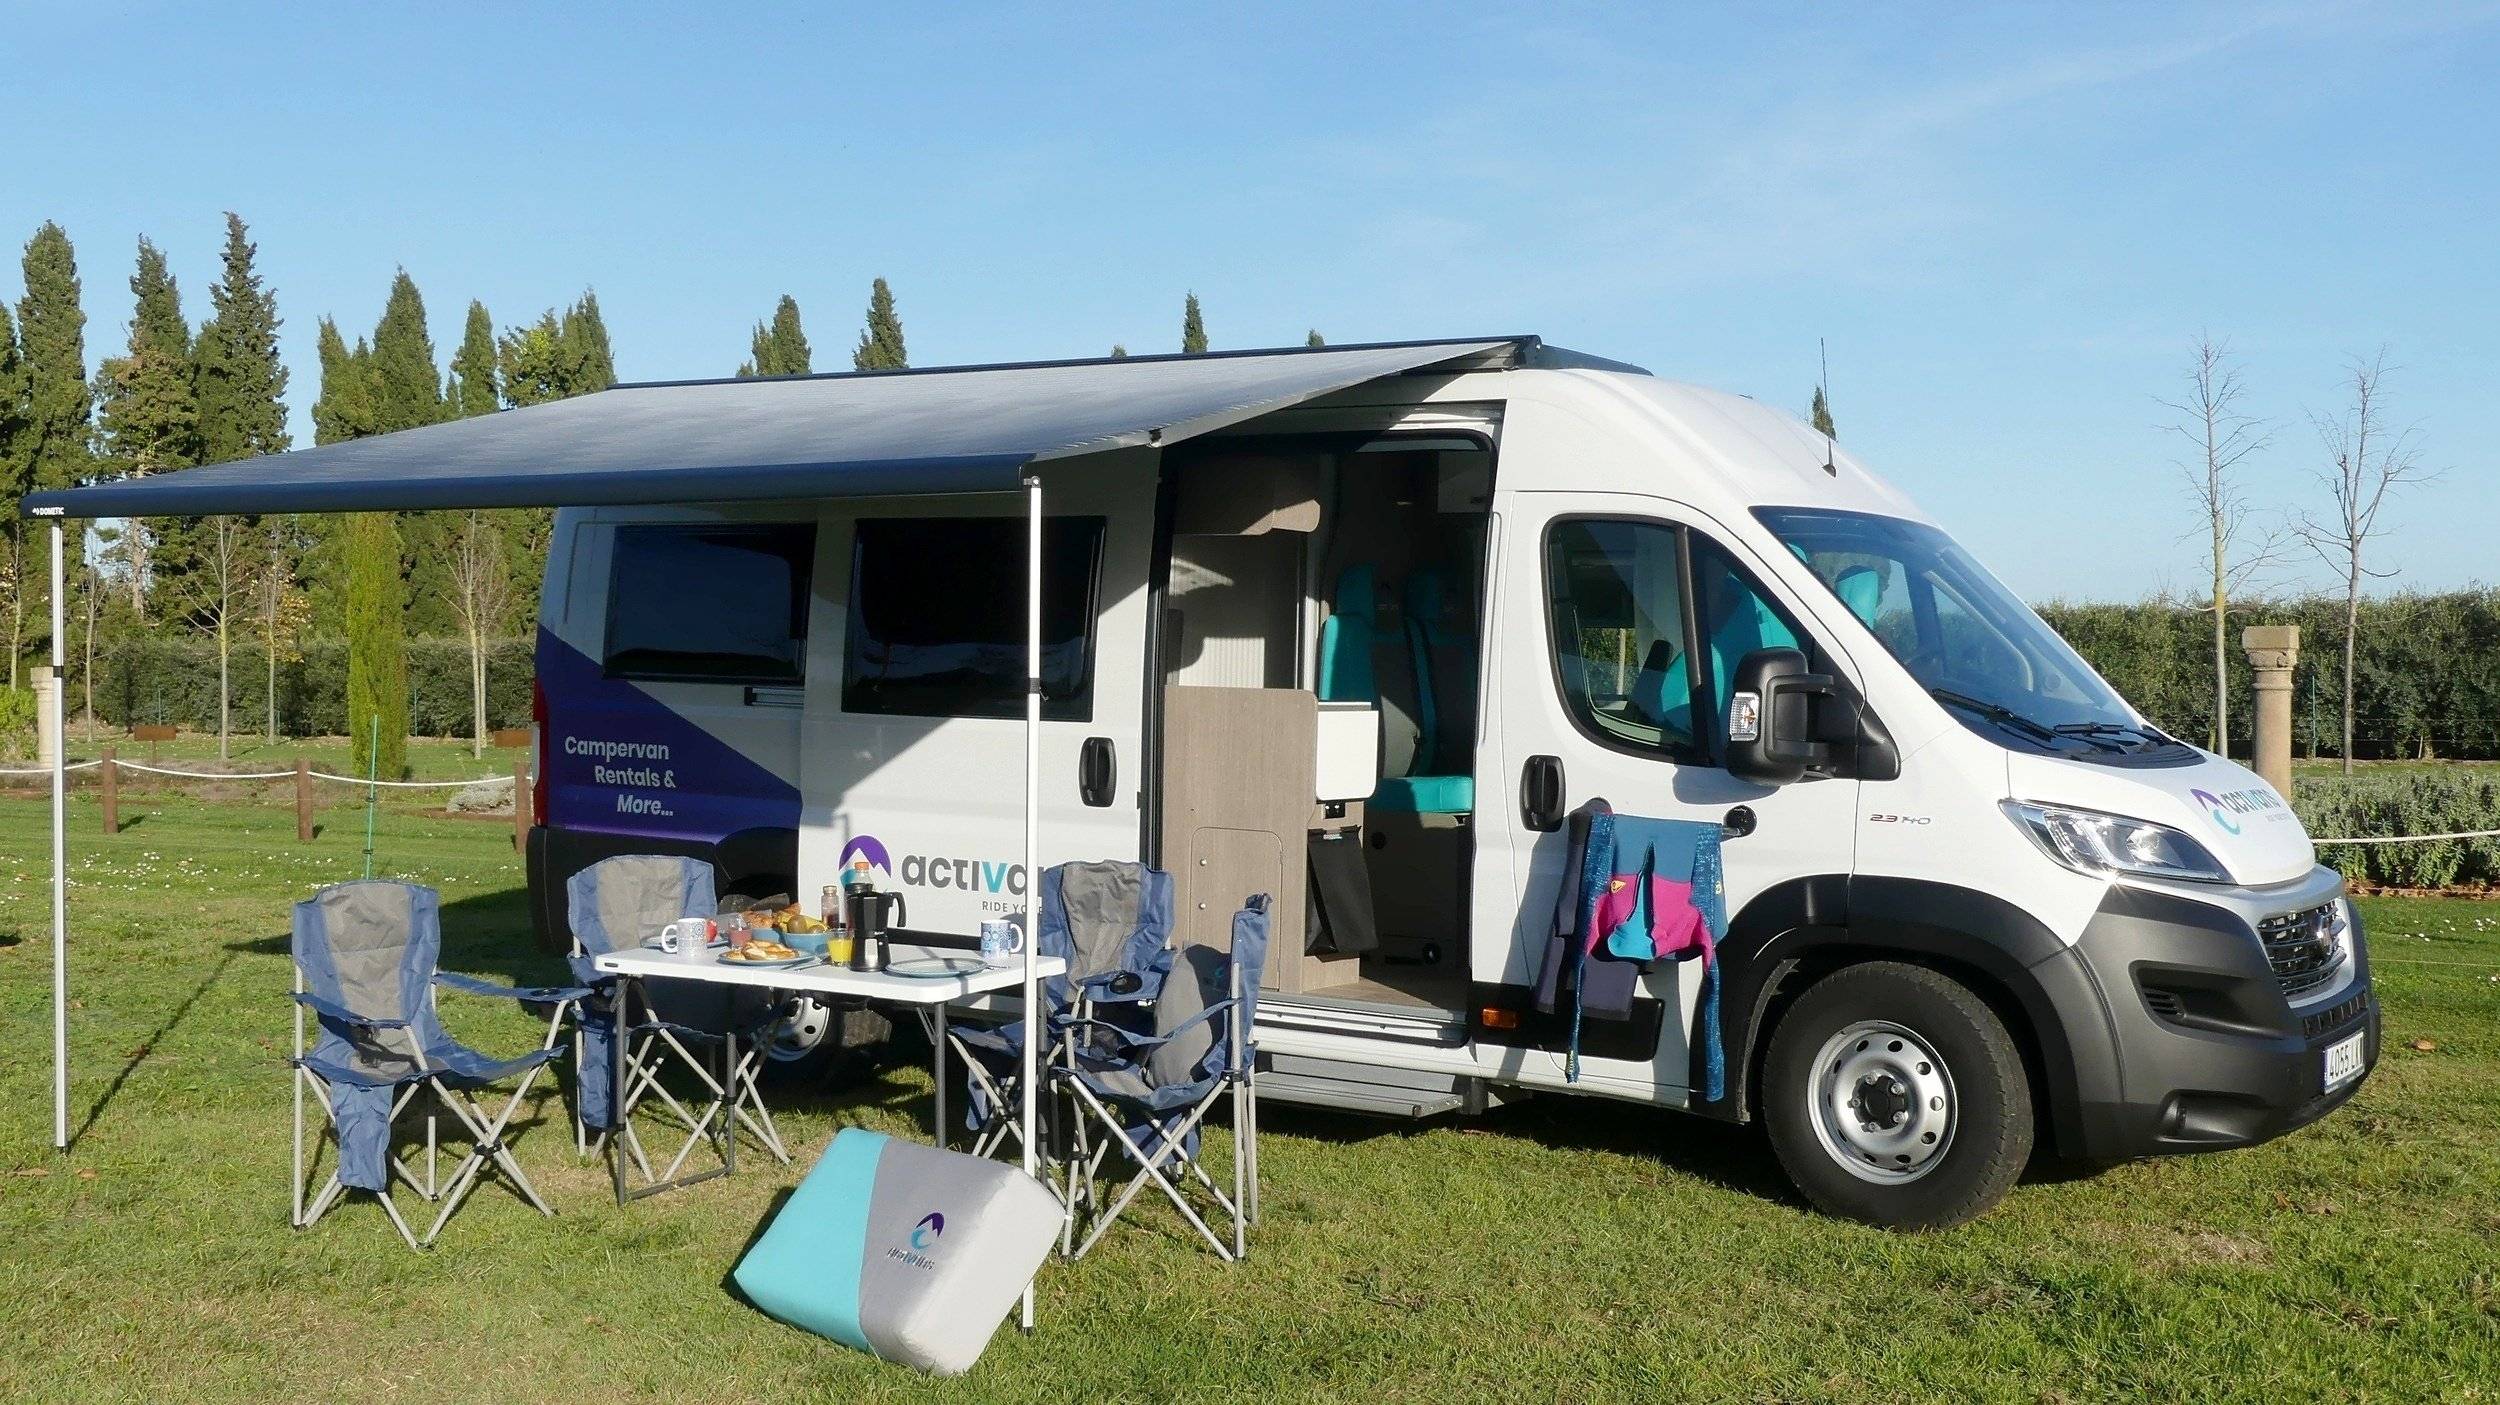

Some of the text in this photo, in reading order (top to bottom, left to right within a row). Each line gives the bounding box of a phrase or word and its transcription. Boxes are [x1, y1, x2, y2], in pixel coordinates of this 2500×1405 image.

[564, 735, 670, 763] Campervan
[594, 764, 677, 788] Rentals &
[616, 793, 675, 817] More...
[901, 854, 1045, 899] activa
[982, 900, 1008, 913] RIDE
